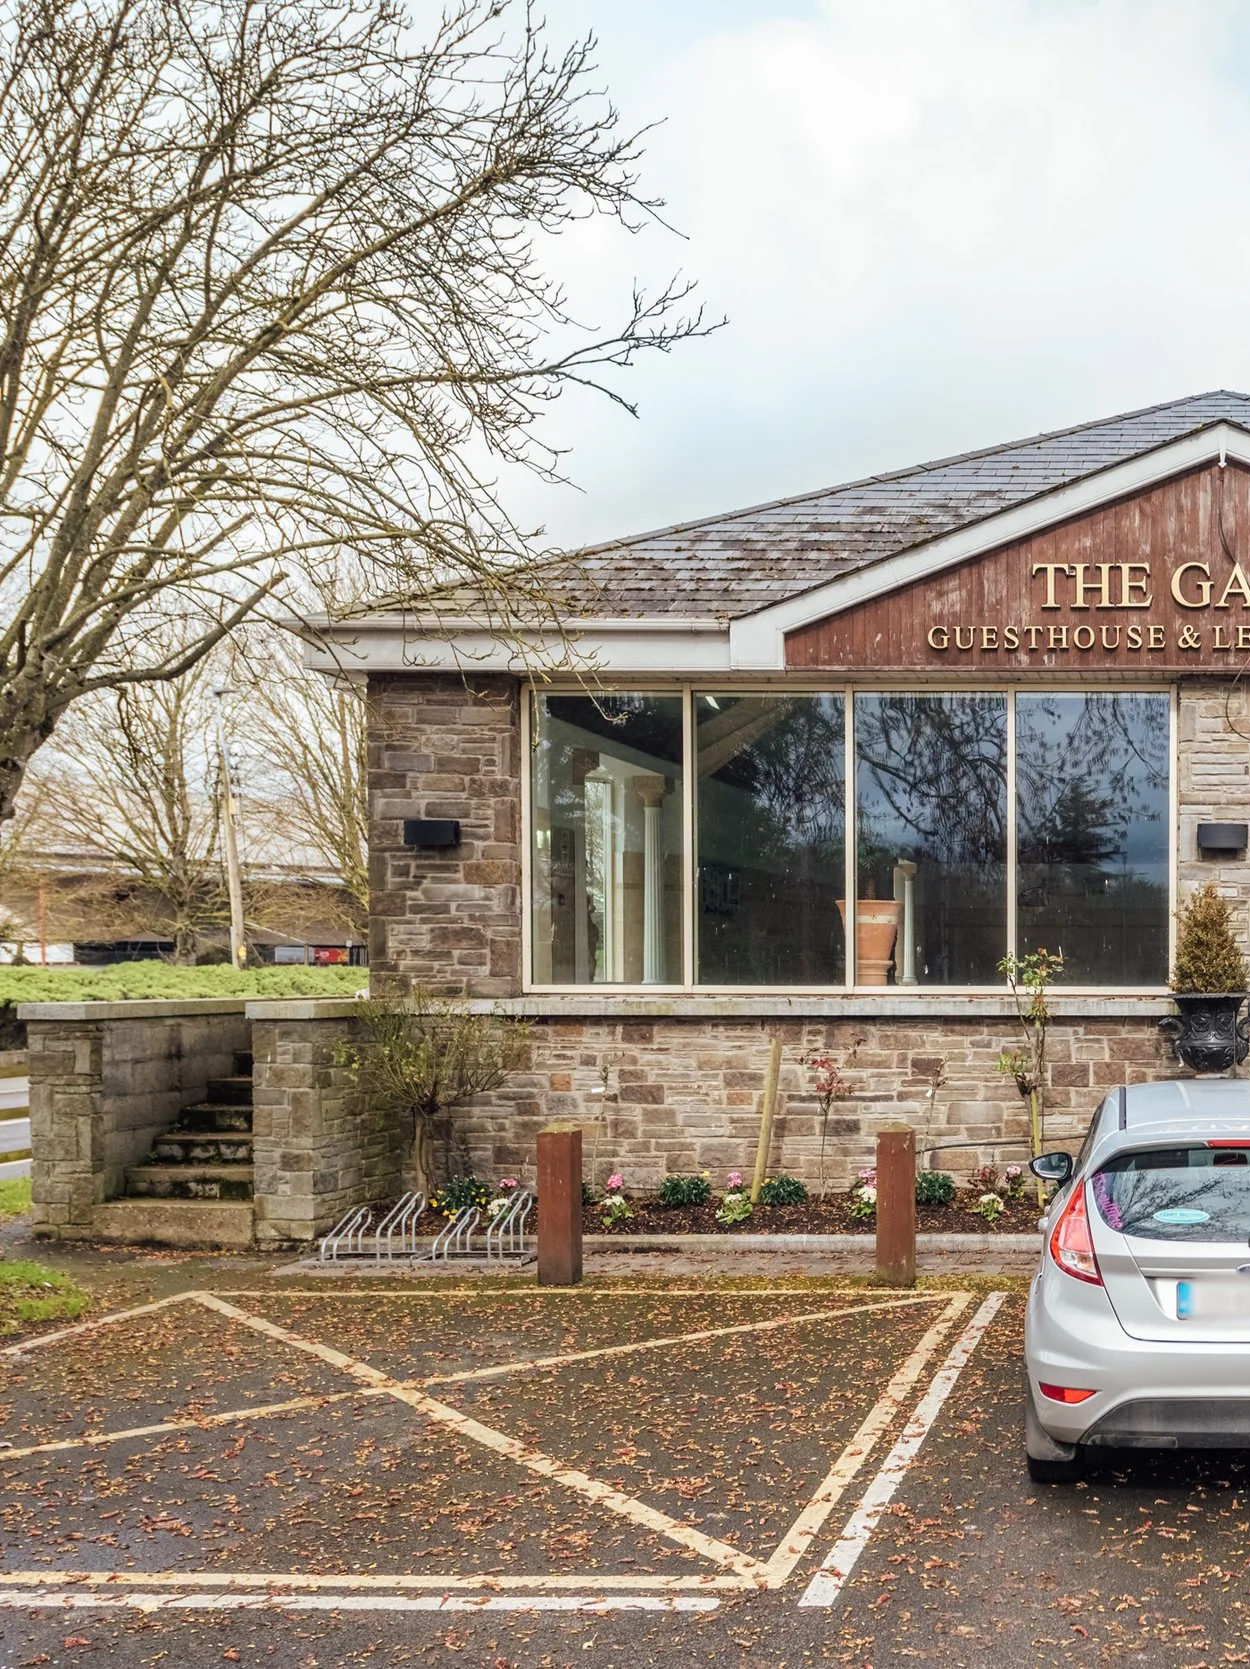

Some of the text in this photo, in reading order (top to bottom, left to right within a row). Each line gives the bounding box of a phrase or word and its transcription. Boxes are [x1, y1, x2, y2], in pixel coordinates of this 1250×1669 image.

[1032, 562, 1153, 609] THE
[927, 625, 1167, 650] GUESTHOUSE
[1177, 624, 1202, 650] &
